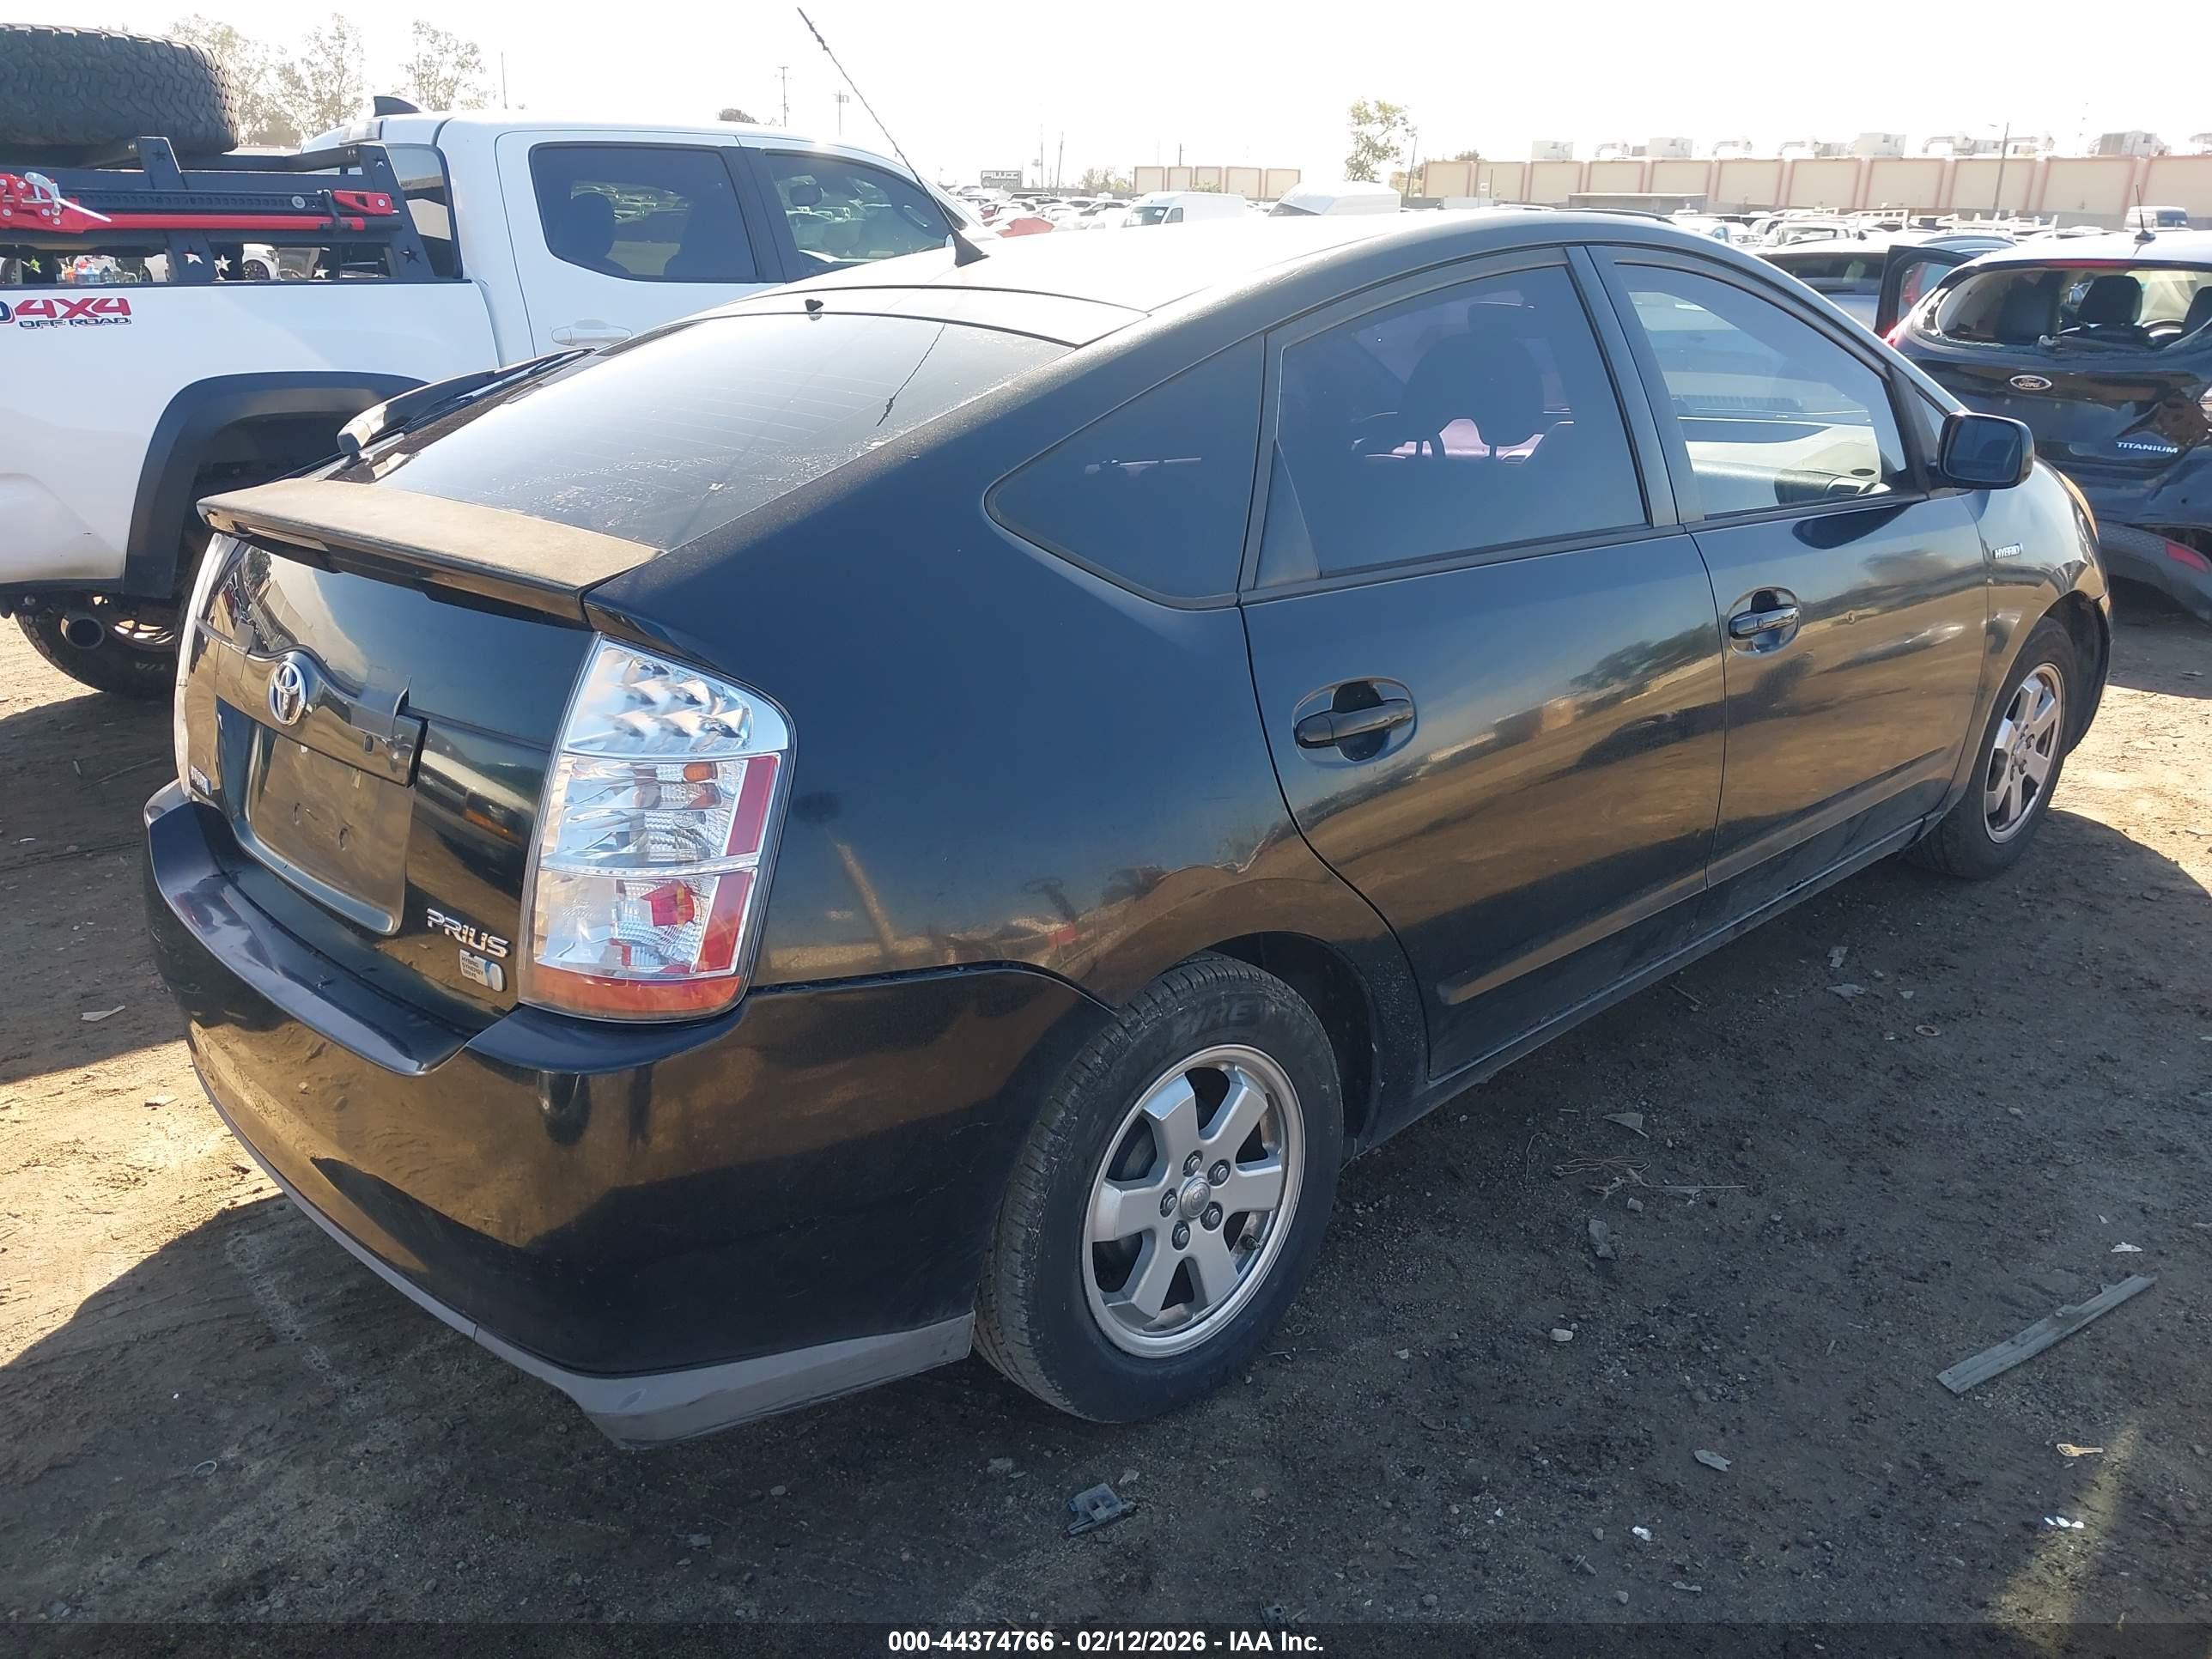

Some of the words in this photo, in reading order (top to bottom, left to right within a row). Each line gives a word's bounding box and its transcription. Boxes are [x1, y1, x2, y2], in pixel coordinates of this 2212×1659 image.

[18, 319, 64, 329] OFF
[69, 317, 131, 327] ROAD
[2116, 441, 2179, 453] TITANIUM
[1995, 544, 2020, 559] HYBRID
[426, 908, 509, 958] PRIUS
